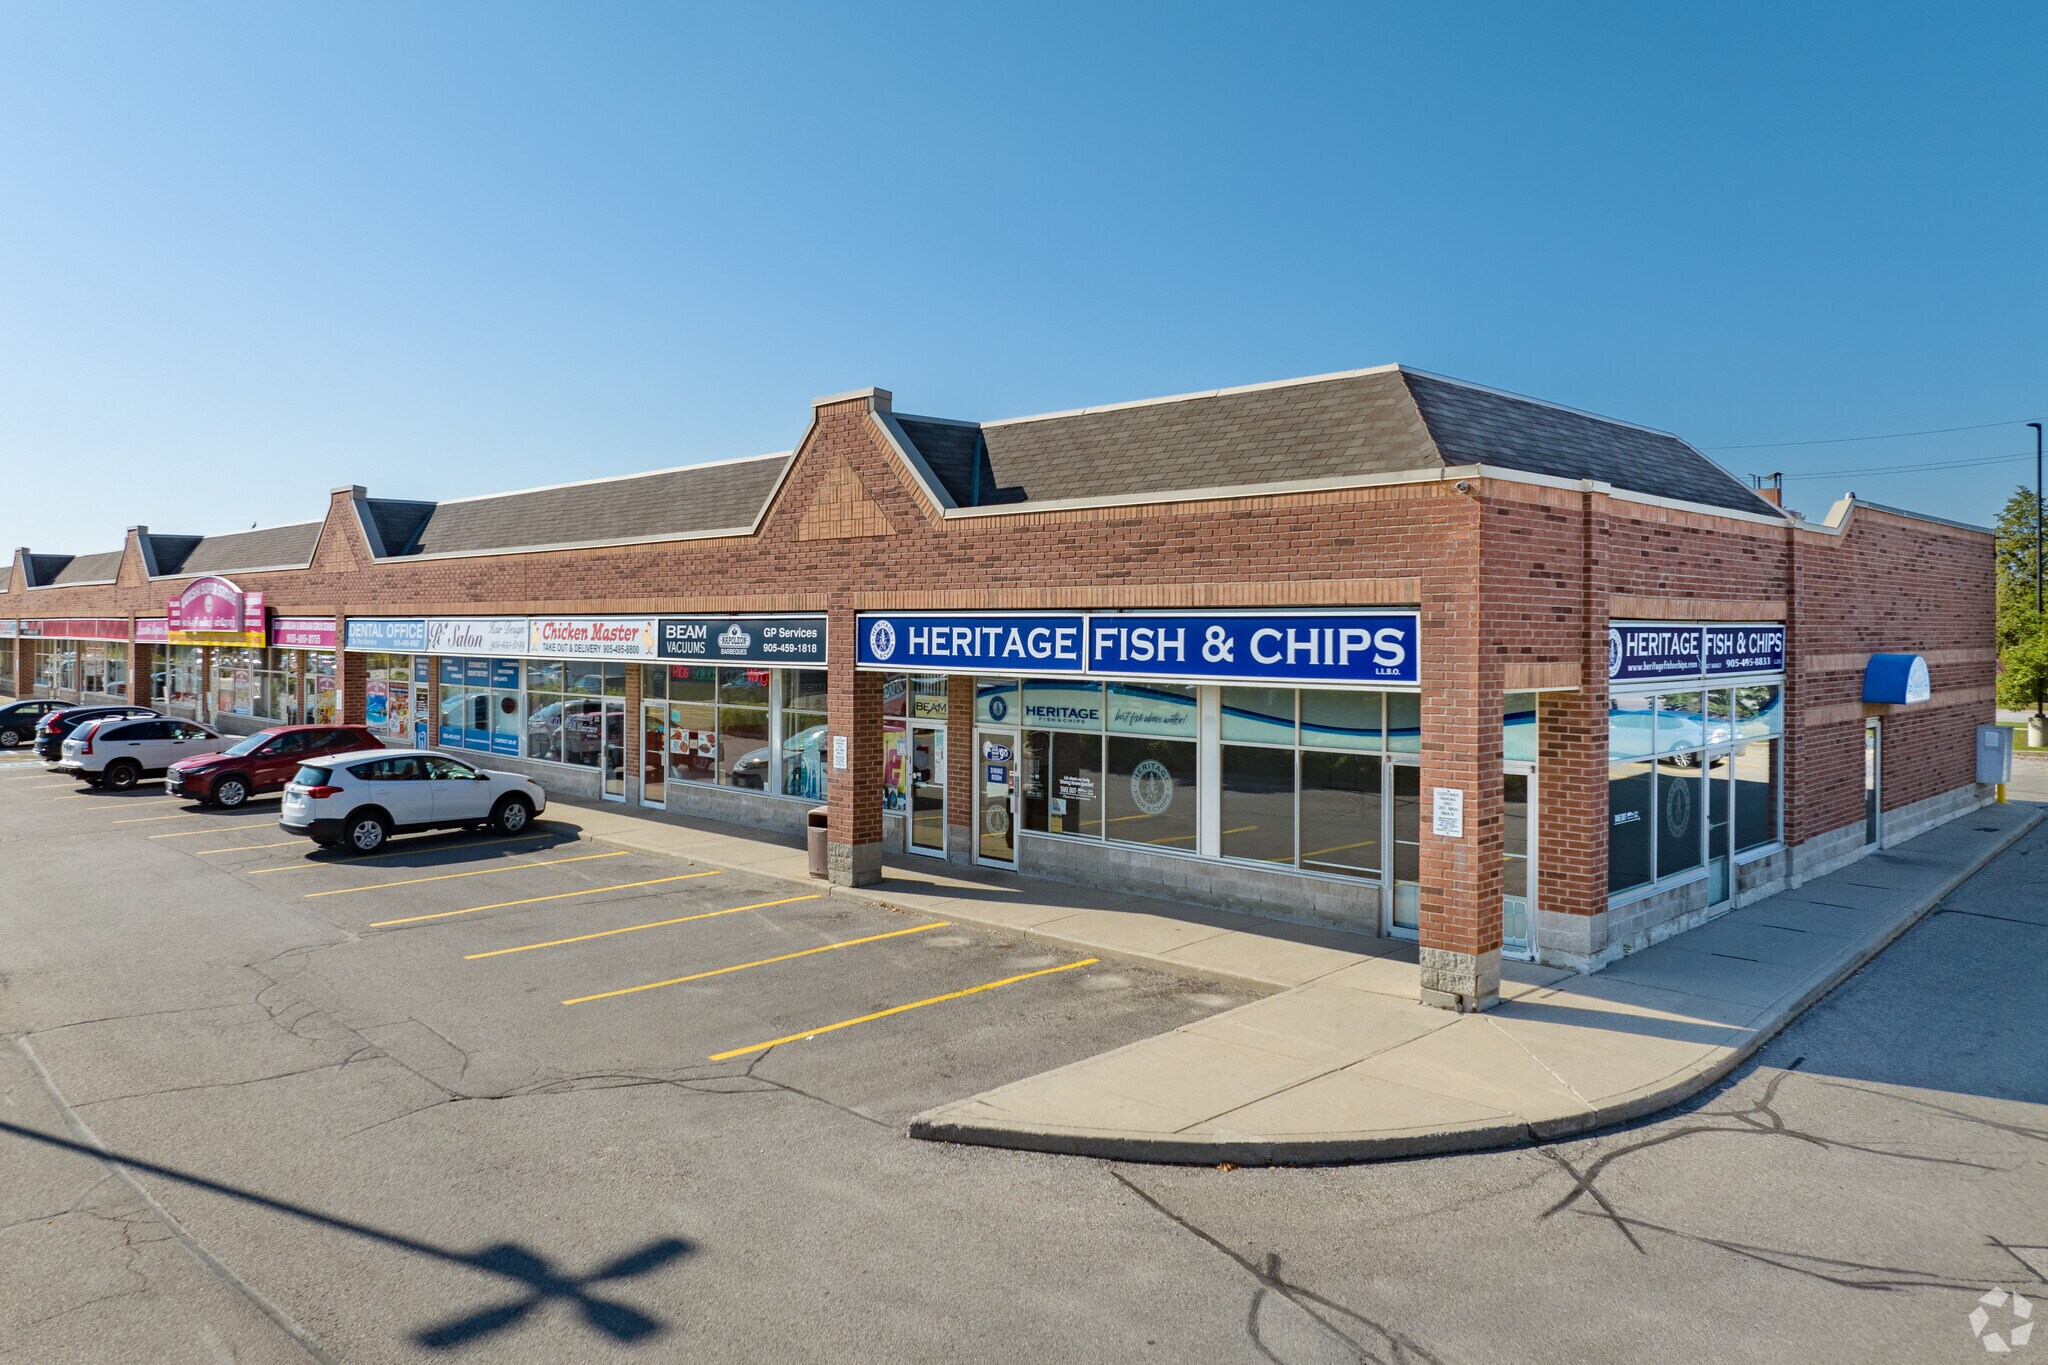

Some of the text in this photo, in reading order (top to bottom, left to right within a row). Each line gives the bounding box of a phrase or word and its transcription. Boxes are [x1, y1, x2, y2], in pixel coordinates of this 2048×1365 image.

[349, 623, 423, 638] DENTAL OFFICE
[448, 624, 482, 647] Salon
[543, 621, 640, 642] Chicken Master
[665, 625, 707, 639] BEAM
[763, 627, 817, 638] GP Services
[666, 641, 706, 654] VACUUMS
[721, 636, 747, 645] NAPOLEON
[908, 625, 1405, 667] HERITAGE FISH & CHIPS
[1626, 632, 1699, 656] HERITAGE
[1706, 633, 1733, 655] FISH
[1737, 632, 1746, 654] &
[1749, 633, 1782, 653] CHIPS
[543, 643, 556, 652] TAKE
[557, 643, 568, 652] OUT
[574, 644, 602, 653] DELIVERY
[763, 643, 817, 653] 905-459-1818
[1726, 657, 1771, 668] 905-495-8833
[916, 702, 947, 714] BEAM
[1025, 706, 1099, 720] HERITAGE
[1134, 762, 1170, 781] HERITAGE
